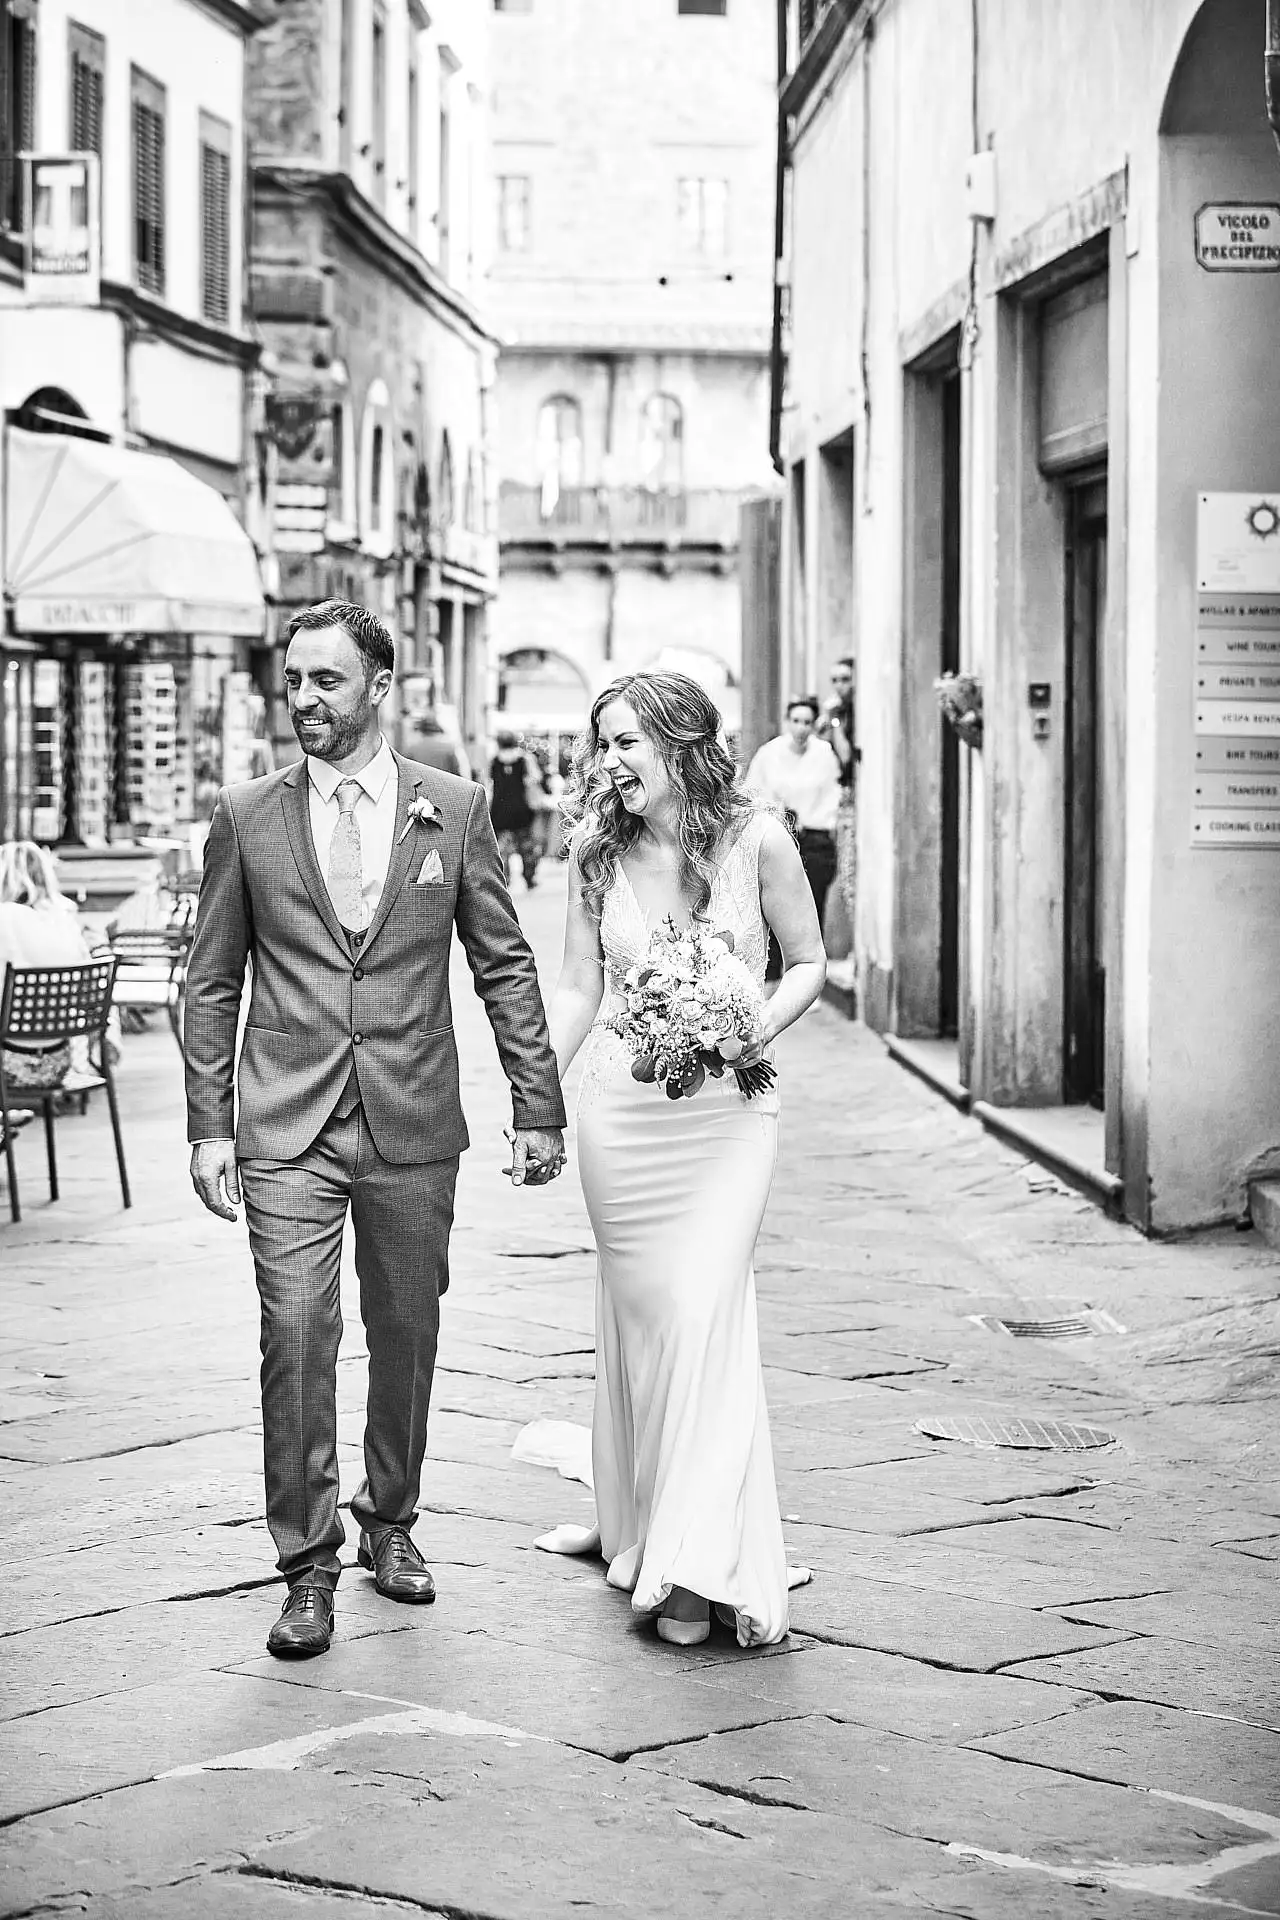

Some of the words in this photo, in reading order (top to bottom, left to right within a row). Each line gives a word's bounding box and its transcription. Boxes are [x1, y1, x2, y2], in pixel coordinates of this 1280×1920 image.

[1217, 214, 1270, 229] VICOLO
[1230, 231, 1253, 242] DEL
[1201, 246, 1280, 260] PRECIPIZIO
[1227, 642, 1248, 652] WINE
[1219, 677, 1255, 687] PRIVATE
[1226, 750, 1246, 760] BIKE
[1249, 750, 1279, 761] TOURS
[1227, 786, 1278, 796] TRANSFERS
[1209, 821, 1251, 832] COOKING
